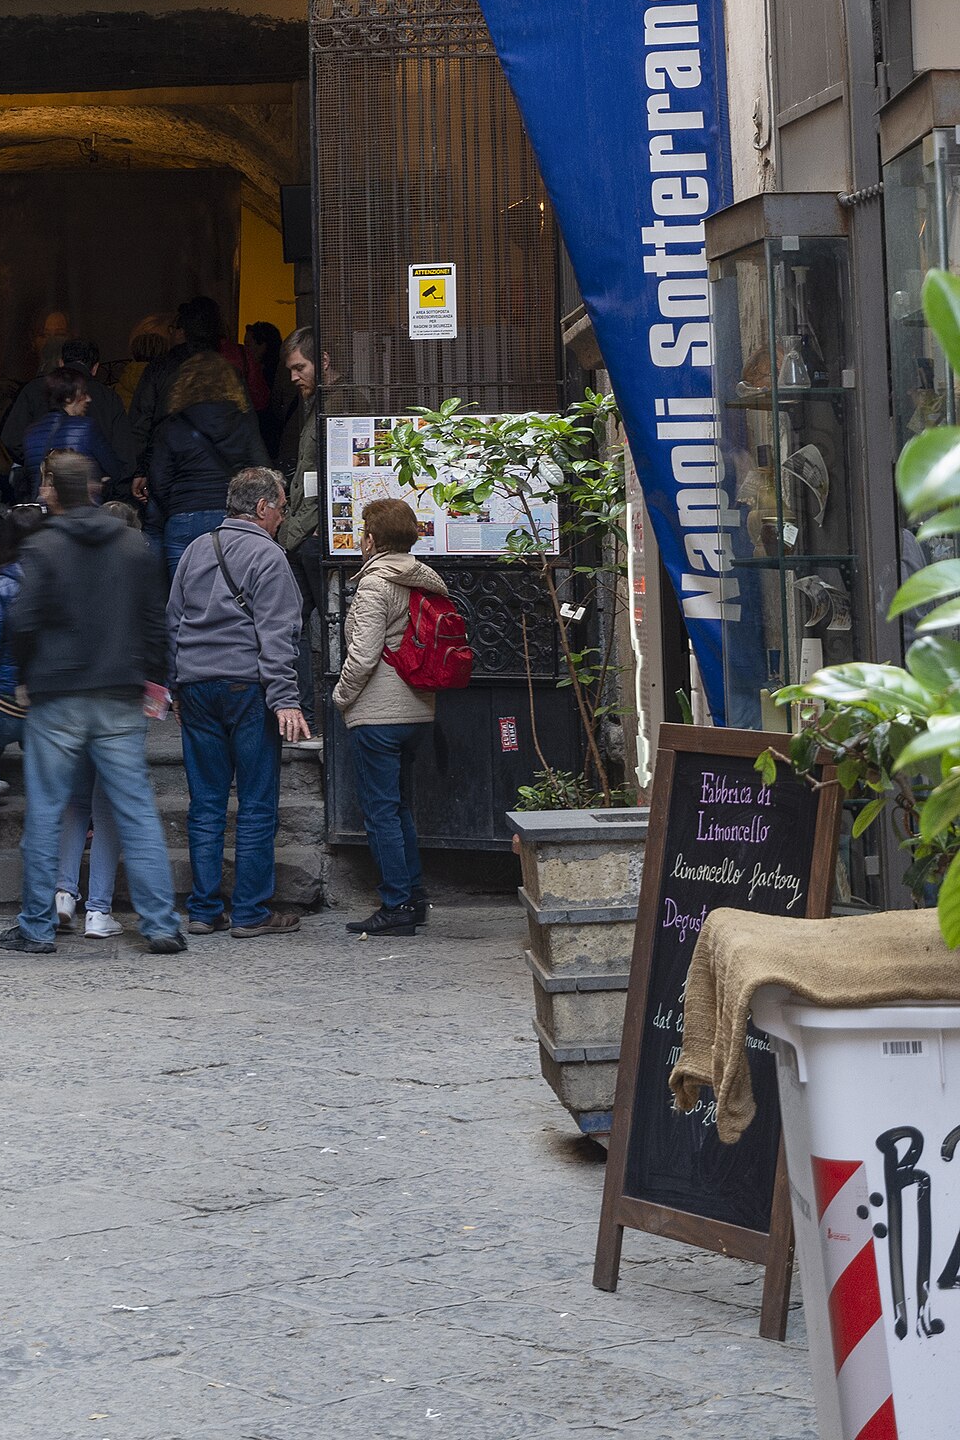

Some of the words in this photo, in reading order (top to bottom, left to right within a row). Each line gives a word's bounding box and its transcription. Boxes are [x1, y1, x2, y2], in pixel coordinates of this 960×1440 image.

[657, 398, 741, 623] Napoli
[699, 771, 753, 805] Fabbrica
[757, 780, 772, 806] di
[696, 810, 771, 843] Limoncello
[670, 853, 746, 885] limoncello
[747, 862, 803, 910] factory
